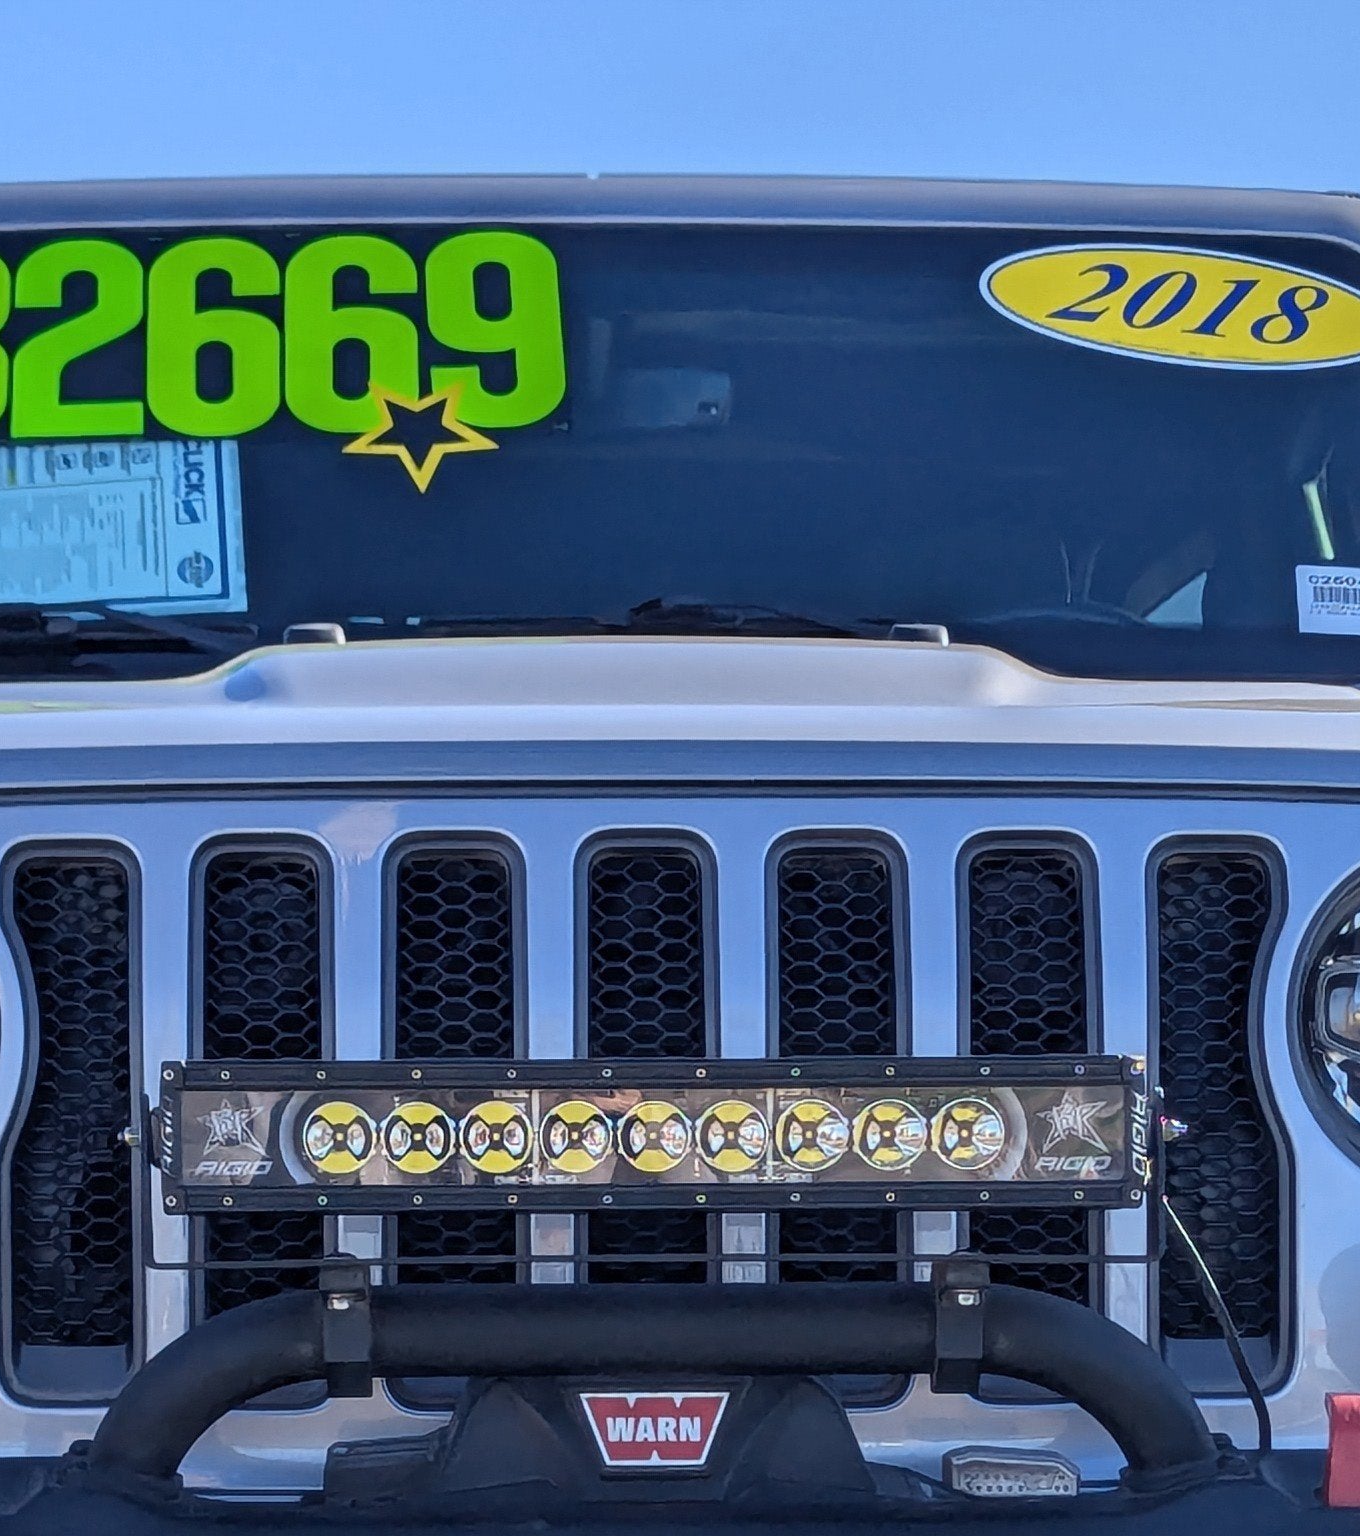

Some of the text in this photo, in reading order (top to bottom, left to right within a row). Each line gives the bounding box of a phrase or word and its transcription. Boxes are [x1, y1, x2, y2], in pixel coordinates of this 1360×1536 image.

[1045, 263, 1330, 345] 2018
[194, 1160, 274, 1176] RIGID
[1034, 1156, 1112, 1172] RIGID
[605, 1416, 702, 1443] WARN
